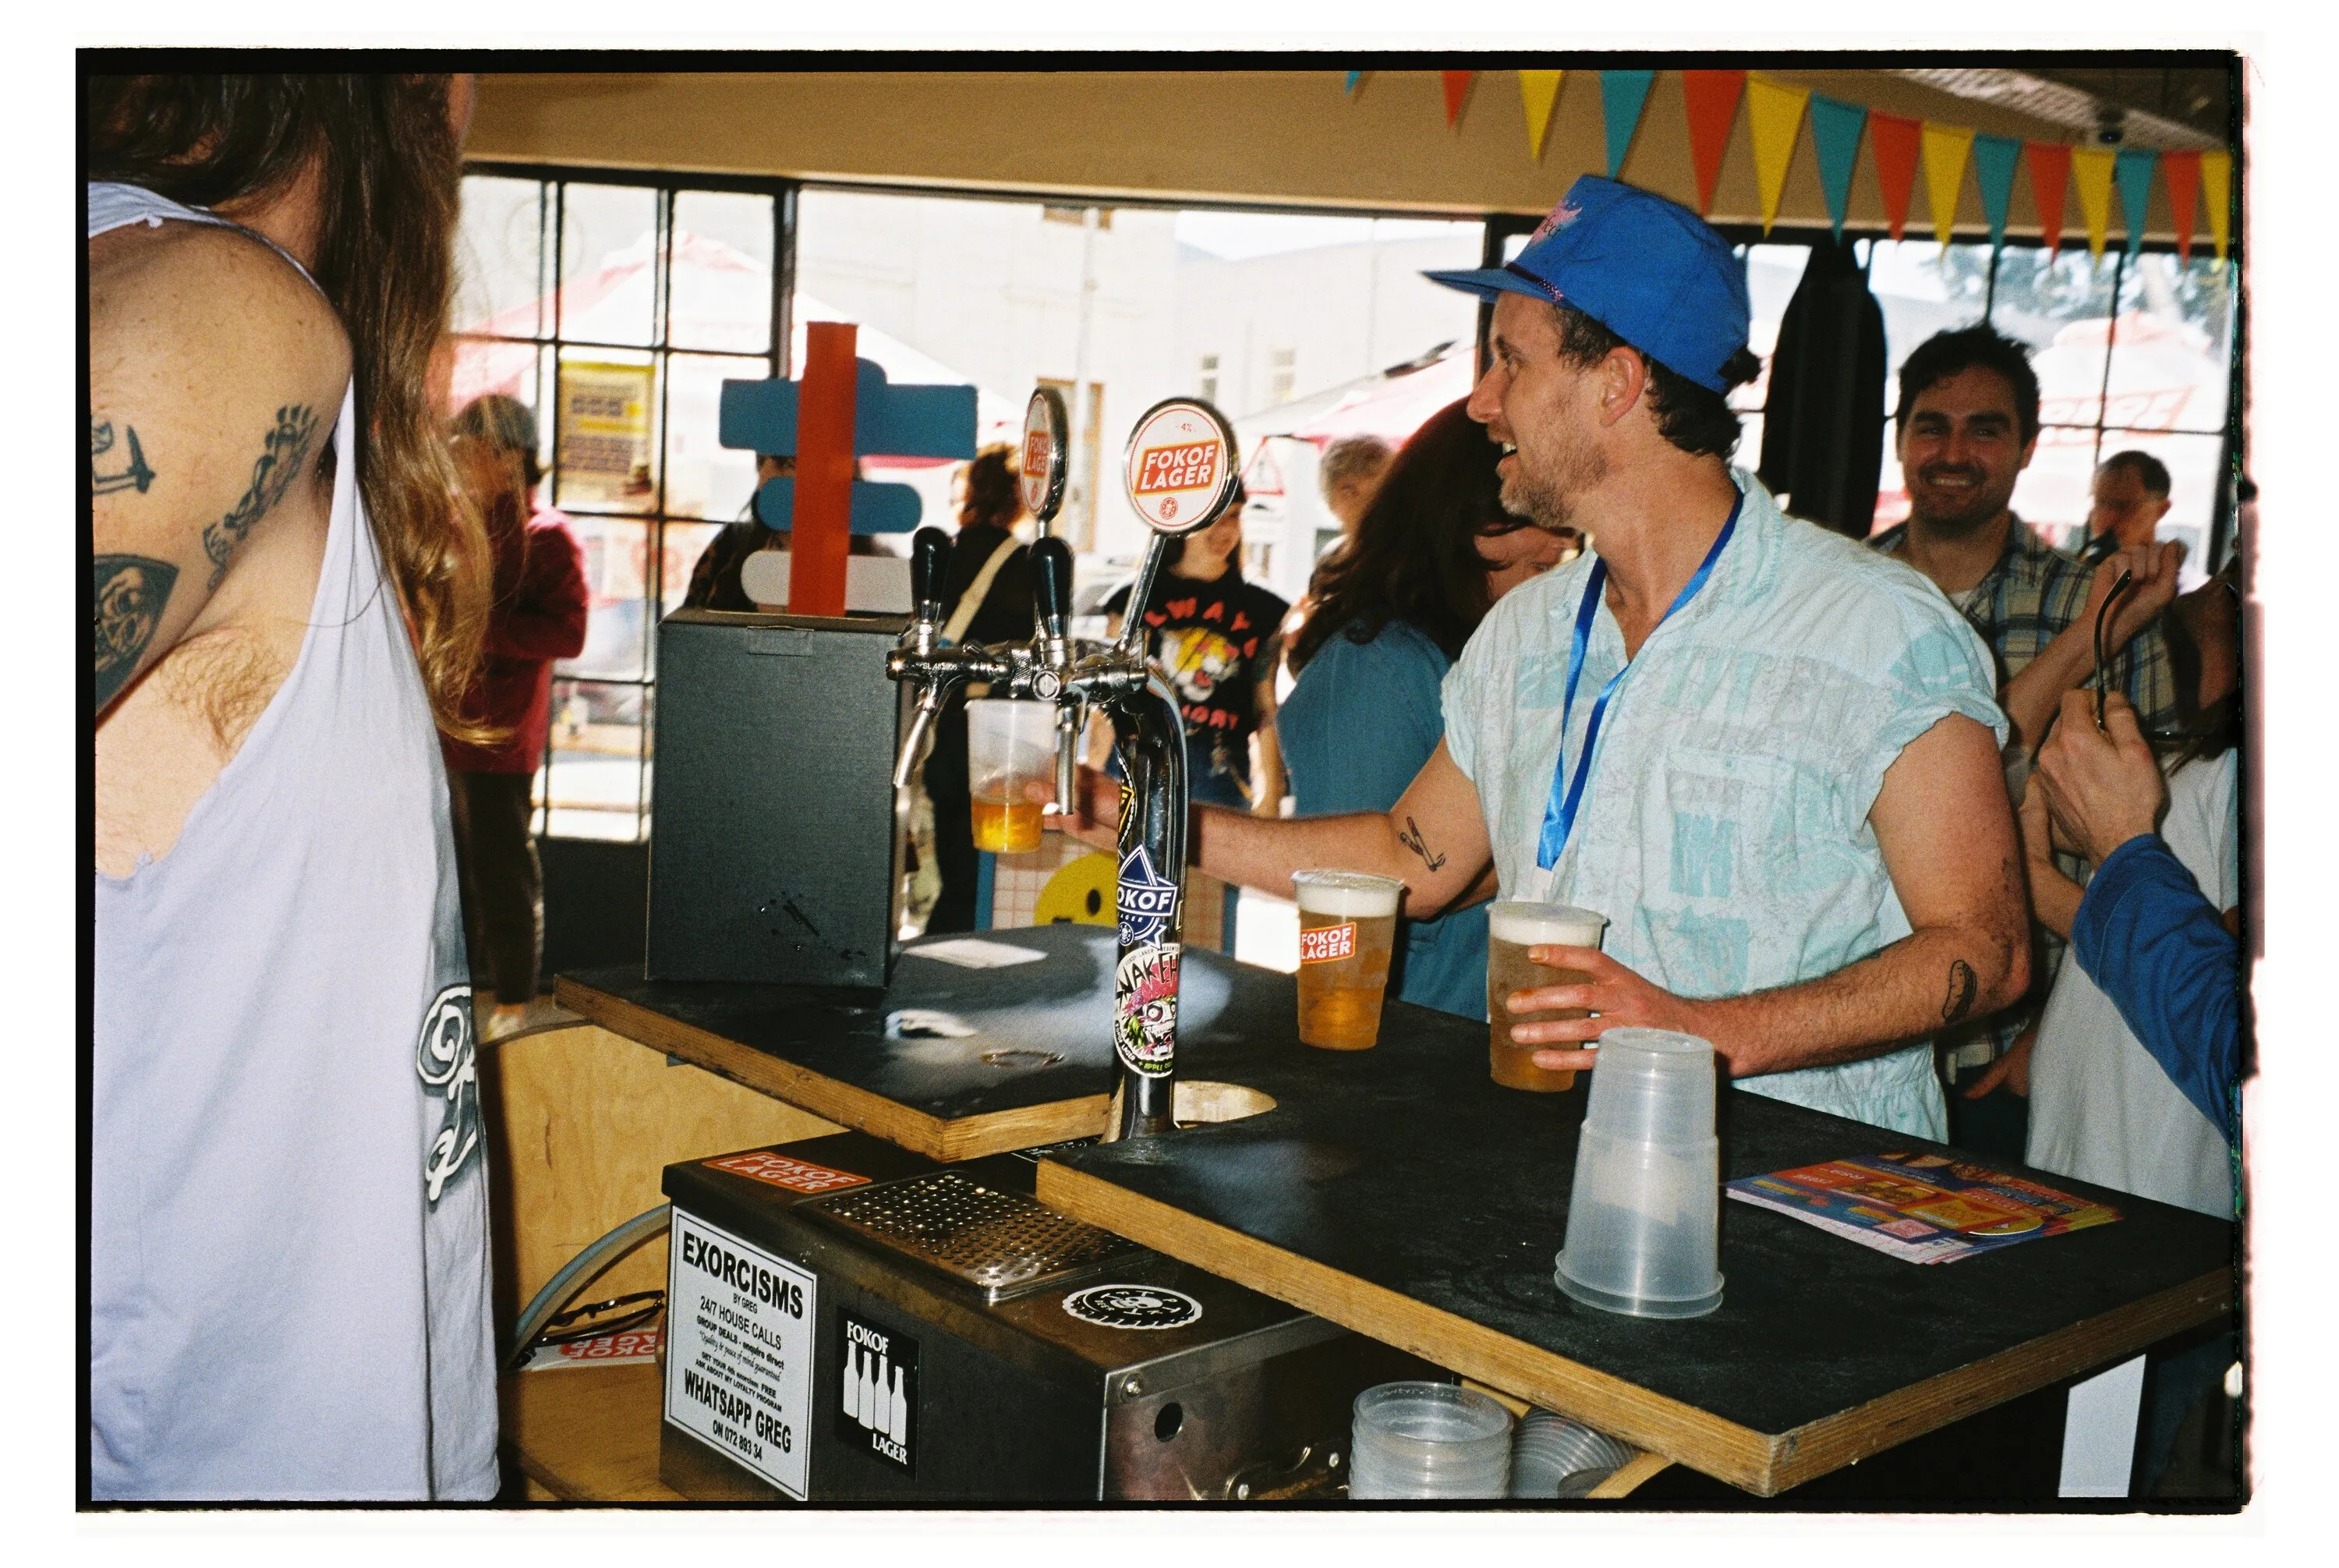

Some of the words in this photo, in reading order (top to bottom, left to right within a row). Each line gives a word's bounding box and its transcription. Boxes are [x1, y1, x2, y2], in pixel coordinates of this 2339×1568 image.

[1029, 436, 1049, 454] FOKO
[1145, 444, 1216, 471] FOKOF
[1025, 454, 1048, 473] LAGE
[1140, 464, 1212, 490] LAGER
[1116, 887, 1173, 911] OKOF
[1118, 913, 1144, 922] AGER
[1301, 926, 1352, 946] FOKOF
[1300, 940, 1351, 960] LAGER
[1144, 1063, 1163, 1071] APPLE
[718, 1159, 830, 1190] LAGER
[745, 1155, 858, 1184] FOKOF
[683, 1230, 803, 1320] EXORCISMS
[733, 1293, 741, 1305] BY
[741, 1297, 757, 1314] GREG
[700, 1295, 717, 1315] 24/7
[719, 1304, 749, 1334] HOUSE
[752, 1322, 781, 1350] CALLS
[568, 1344, 655, 1357] OKOF
[570, 1335, 655, 1348] AGER
[697, 1315, 717, 1332] GROUP
[719, 1326, 738, 1344] DEALS
[742, 1342, 765, 1359] enquire
[766, 1353, 784, 1370] direct
[847, 1320, 889, 1355] FOKOF
[695, 1358, 706, 1369] ASK
[706, 1365, 724, 1379] ABOUT
[724, 1375, 733, 1384] MY
[733, 1379, 755, 1397] LOYALTY
[756, 1392, 782, 1413] PROGRAM
[713, 1357, 726, 1371] YOUR
[761, 1383, 777, 1399] FREE
[685, 1368, 752, 1429] WHATSAPP
[755, 1410, 791, 1454] GREG
[713, 1419, 724, 1439] ON
[724, 1426, 738, 1446] 072
[753, 1443, 763, 1462] 34
[872, 1433, 908, 1465] LAGER
